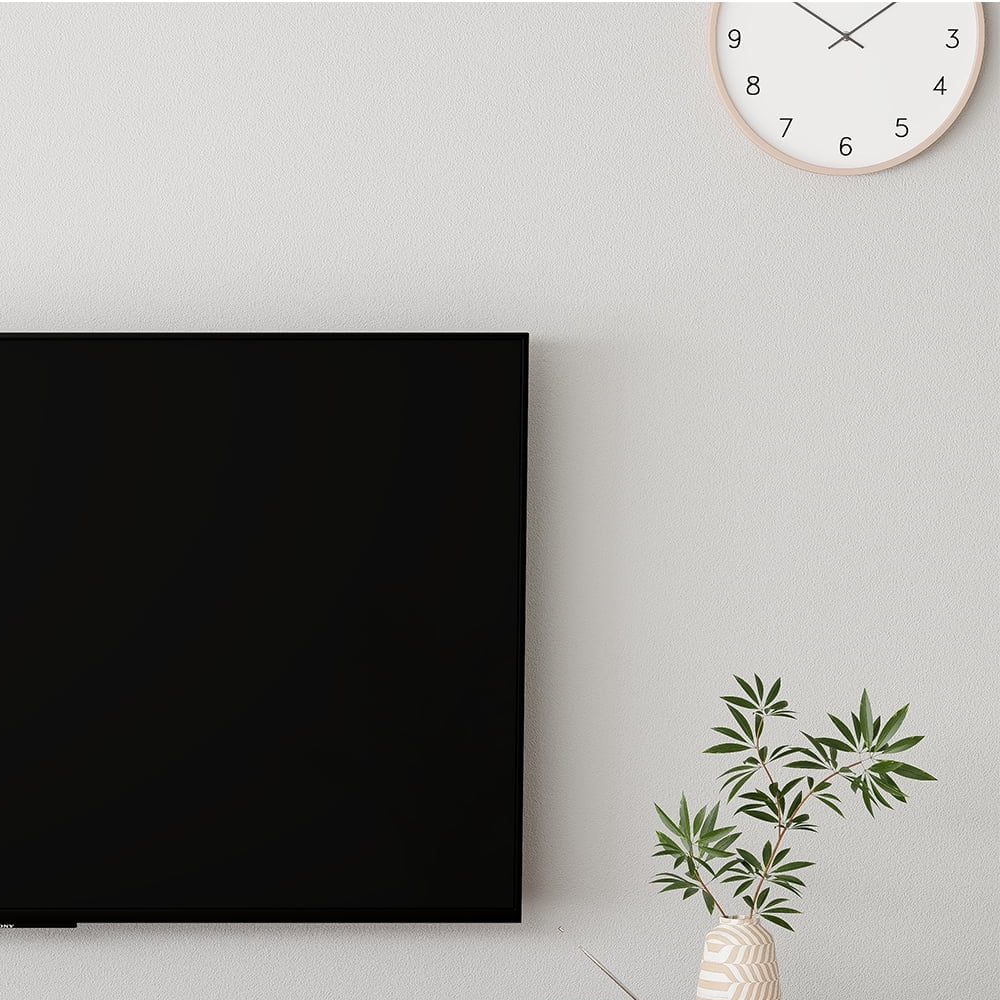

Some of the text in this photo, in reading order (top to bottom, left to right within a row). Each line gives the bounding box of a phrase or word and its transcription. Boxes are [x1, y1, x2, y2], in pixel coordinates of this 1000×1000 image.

[727, 28, 742, 49] 9
[945, 28, 960, 49] 3
[746, 75, 761, 96] 8
[932, 75, 948, 96] 4
[779, 117, 794, 138] 7
[894, 117, 909, 138] 5
[838, 136, 853, 157] 6
